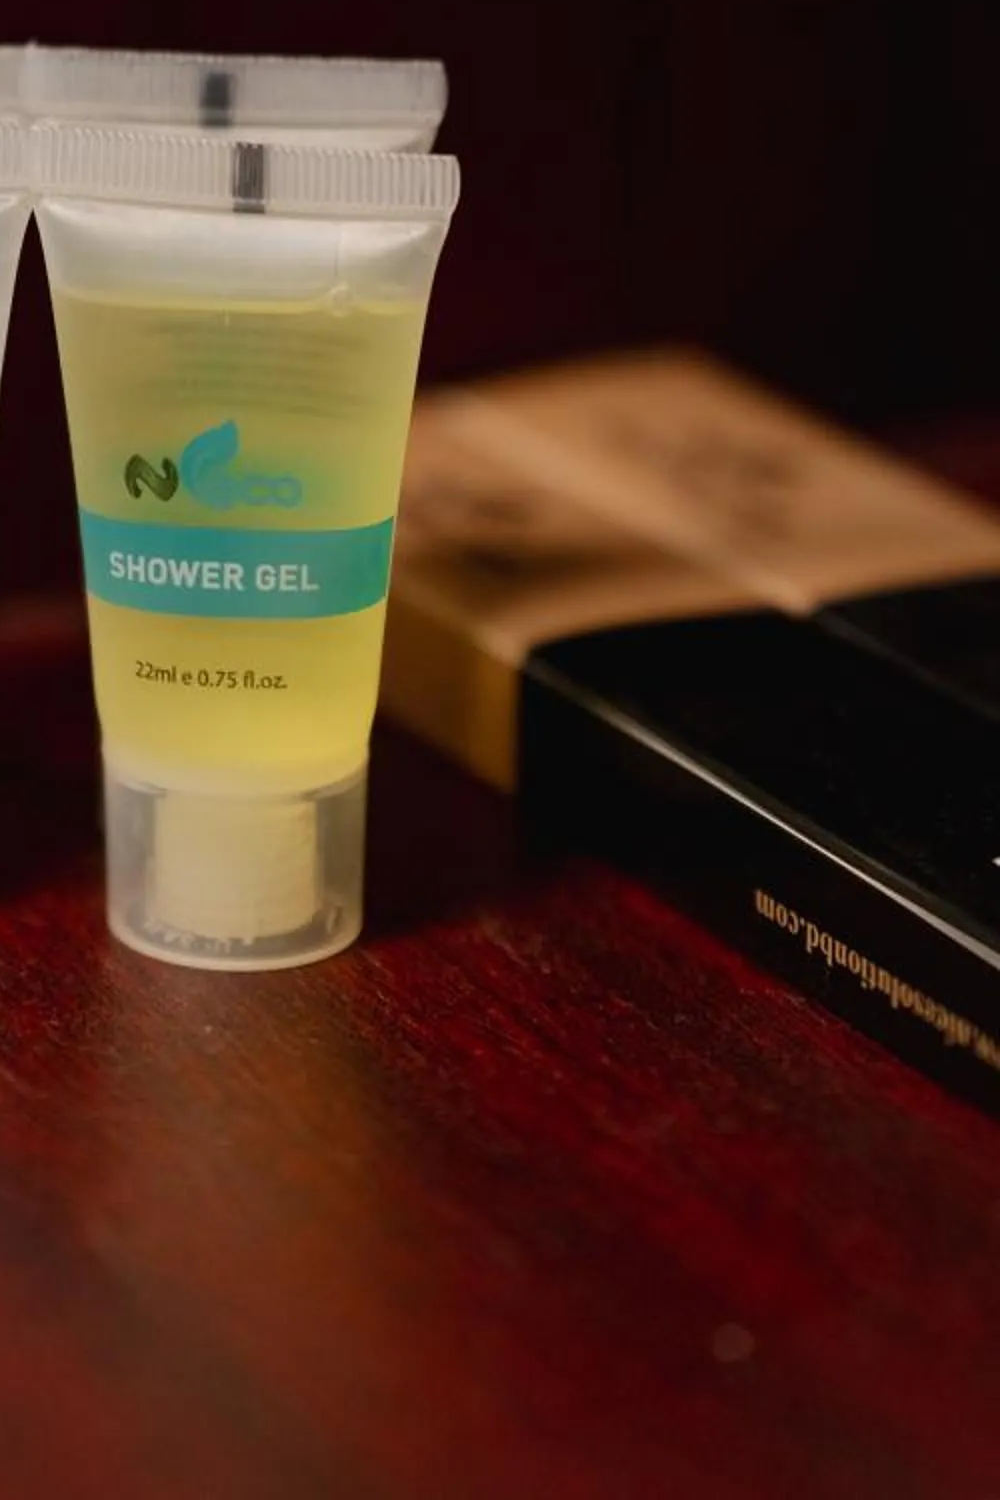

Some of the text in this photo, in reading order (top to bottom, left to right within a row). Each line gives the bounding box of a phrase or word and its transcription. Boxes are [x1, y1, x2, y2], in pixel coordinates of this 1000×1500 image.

[109, 551, 321, 592] SHOWER GEL
[134, 660, 178, 684] 22ml
[197, 670, 238, 689] 0.75
